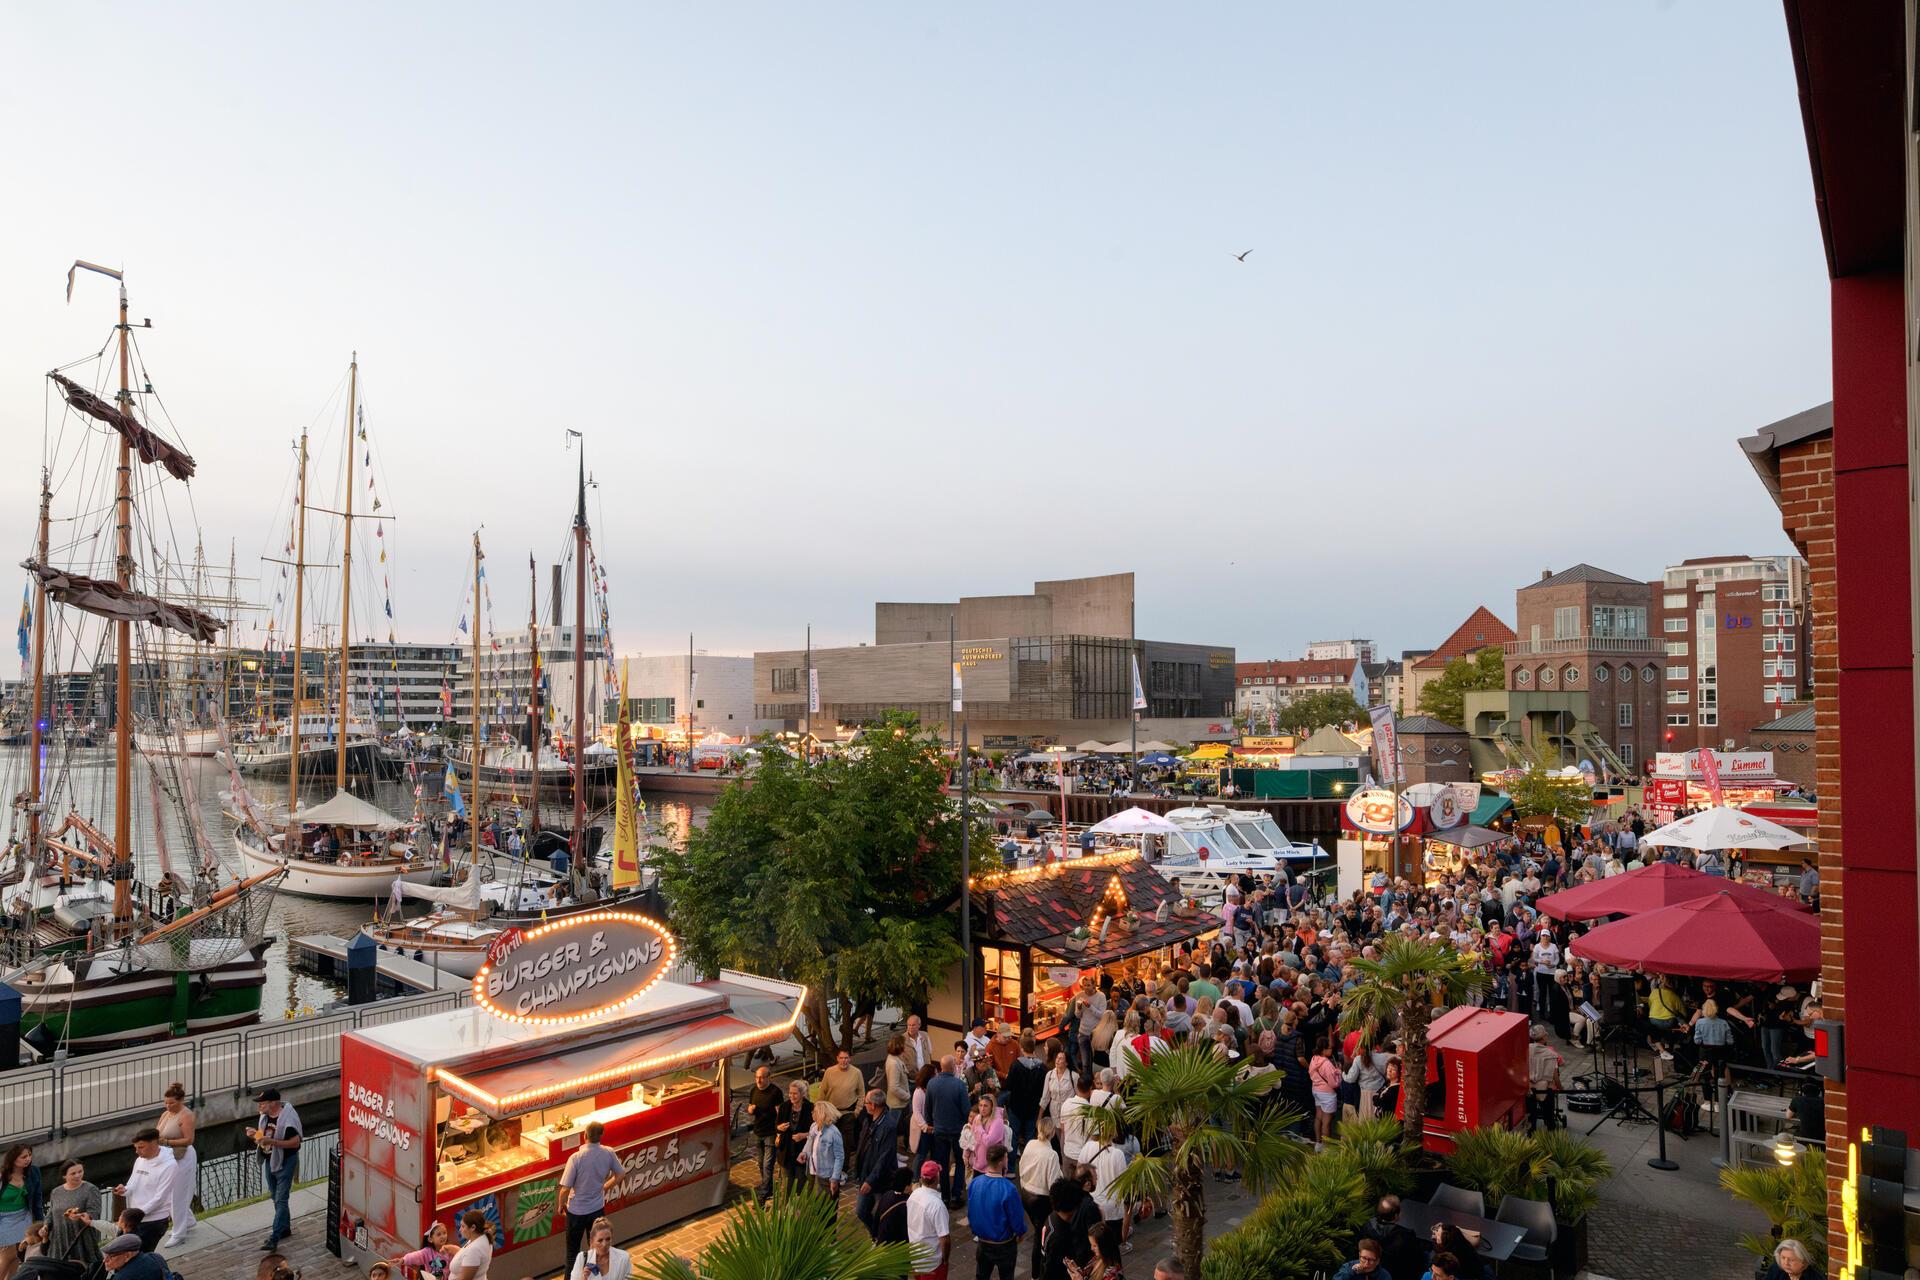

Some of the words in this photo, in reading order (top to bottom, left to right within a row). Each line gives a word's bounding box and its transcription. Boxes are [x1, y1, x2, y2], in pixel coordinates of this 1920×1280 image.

[1731, 758, 1766, 771] Lümmel
[487, 942, 581, 998] BURGER
[589, 931, 608, 957] &
[516, 936, 665, 1017] CHAMPIGNONS
[1456, 1060, 1464, 1088] JETZT
[348, 1081, 383, 1114] BURGER
[385, 1099, 394, 1118] &
[348, 1105, 411, 1151] CHAMPIGNONS
[602, 1149, 707, 1203] HAMPIGNONS
[622, 1145, 659, 1173] GER
[664, 1138, 679, 1160] &
